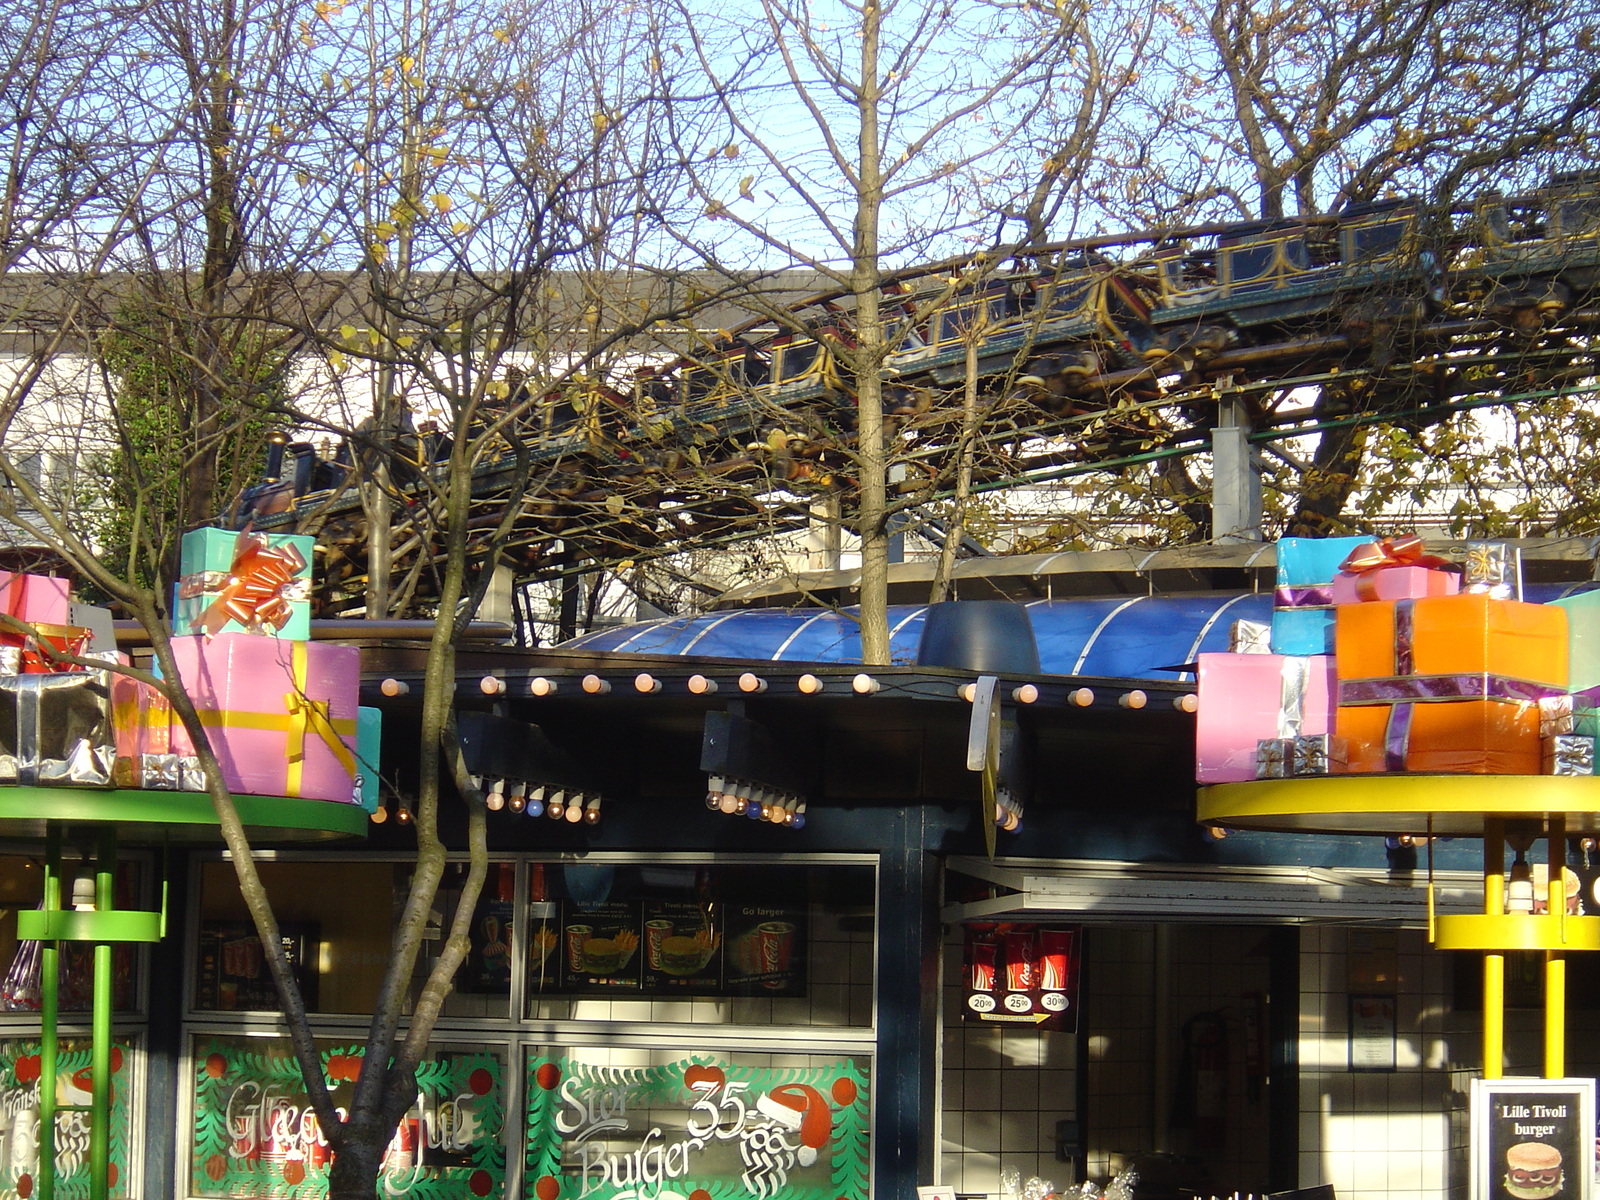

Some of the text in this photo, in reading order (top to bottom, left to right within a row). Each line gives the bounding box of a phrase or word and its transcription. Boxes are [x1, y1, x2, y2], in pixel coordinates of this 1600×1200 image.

[742, 907, 785, 918] Go larger
[555, 1076, 638, 1134] Stor
[1502, 1104, 1567, 1118] Lille Tivoli
[385, 1092, 474, 1196] Jul
[1514, 1122, 1556, 1138] burger
[573, 1127, 705, 1200] Burger
